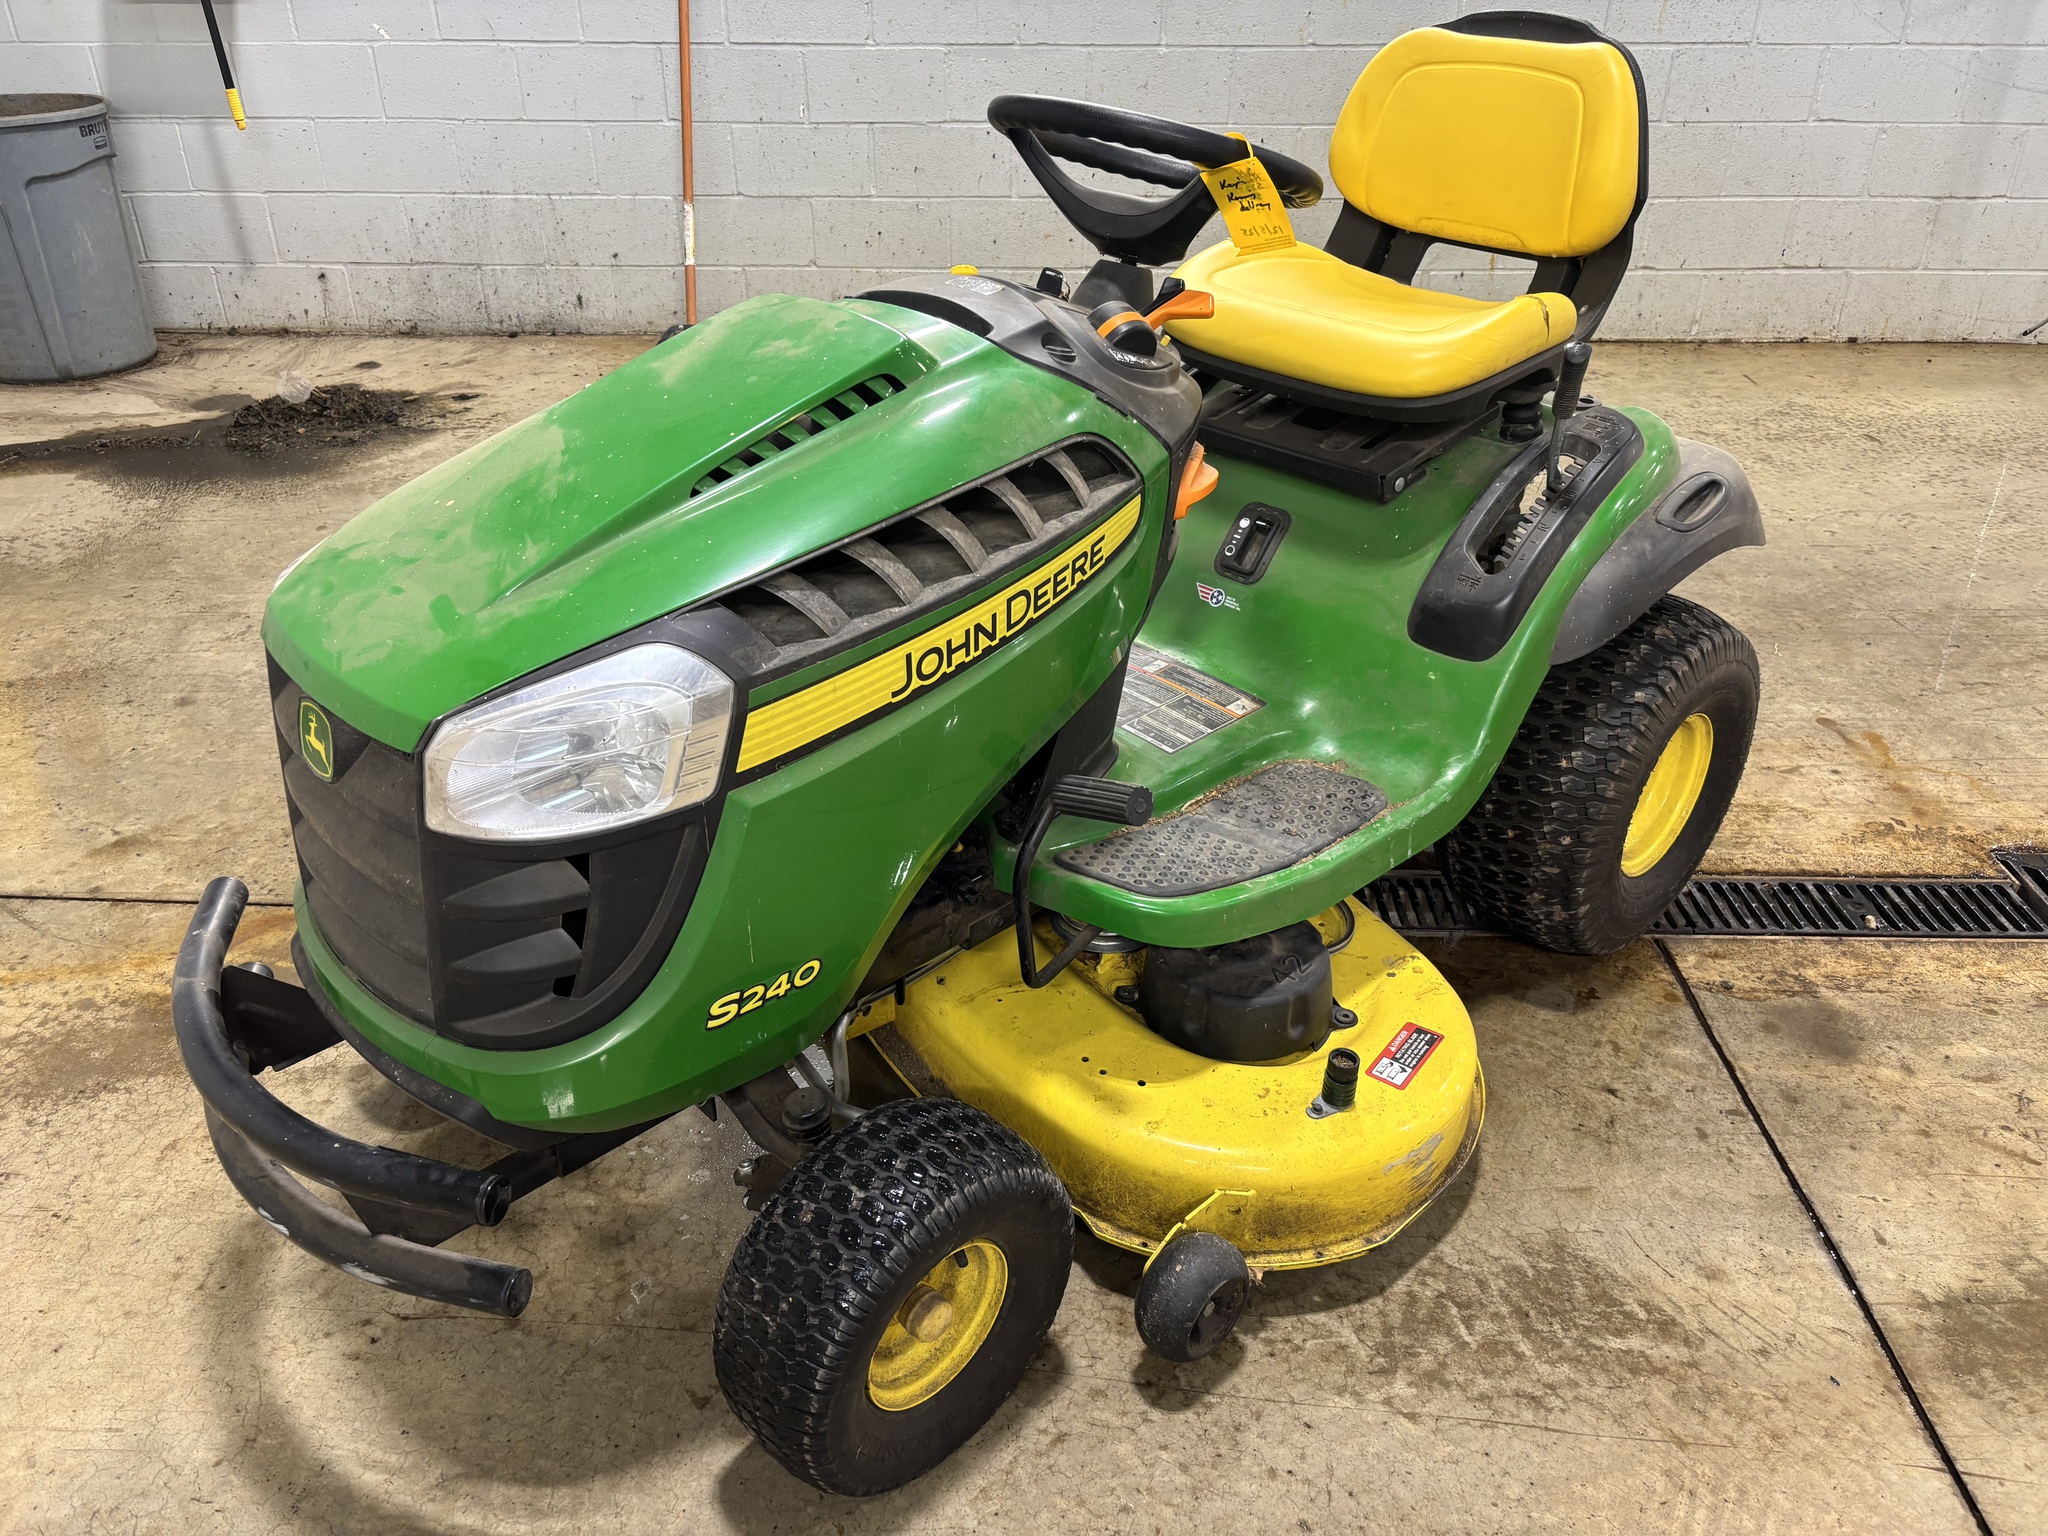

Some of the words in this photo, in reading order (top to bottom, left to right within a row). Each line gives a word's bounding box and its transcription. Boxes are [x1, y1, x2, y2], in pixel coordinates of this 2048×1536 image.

[890, 612, 997, 699] JOHN
[1006, 534, 1106, 633] DEERE
[706, 959, 821, 1029] S240
[1270, 953, 1314, 985] 42
[1391, 1030, 1409, 1048] DANGER
